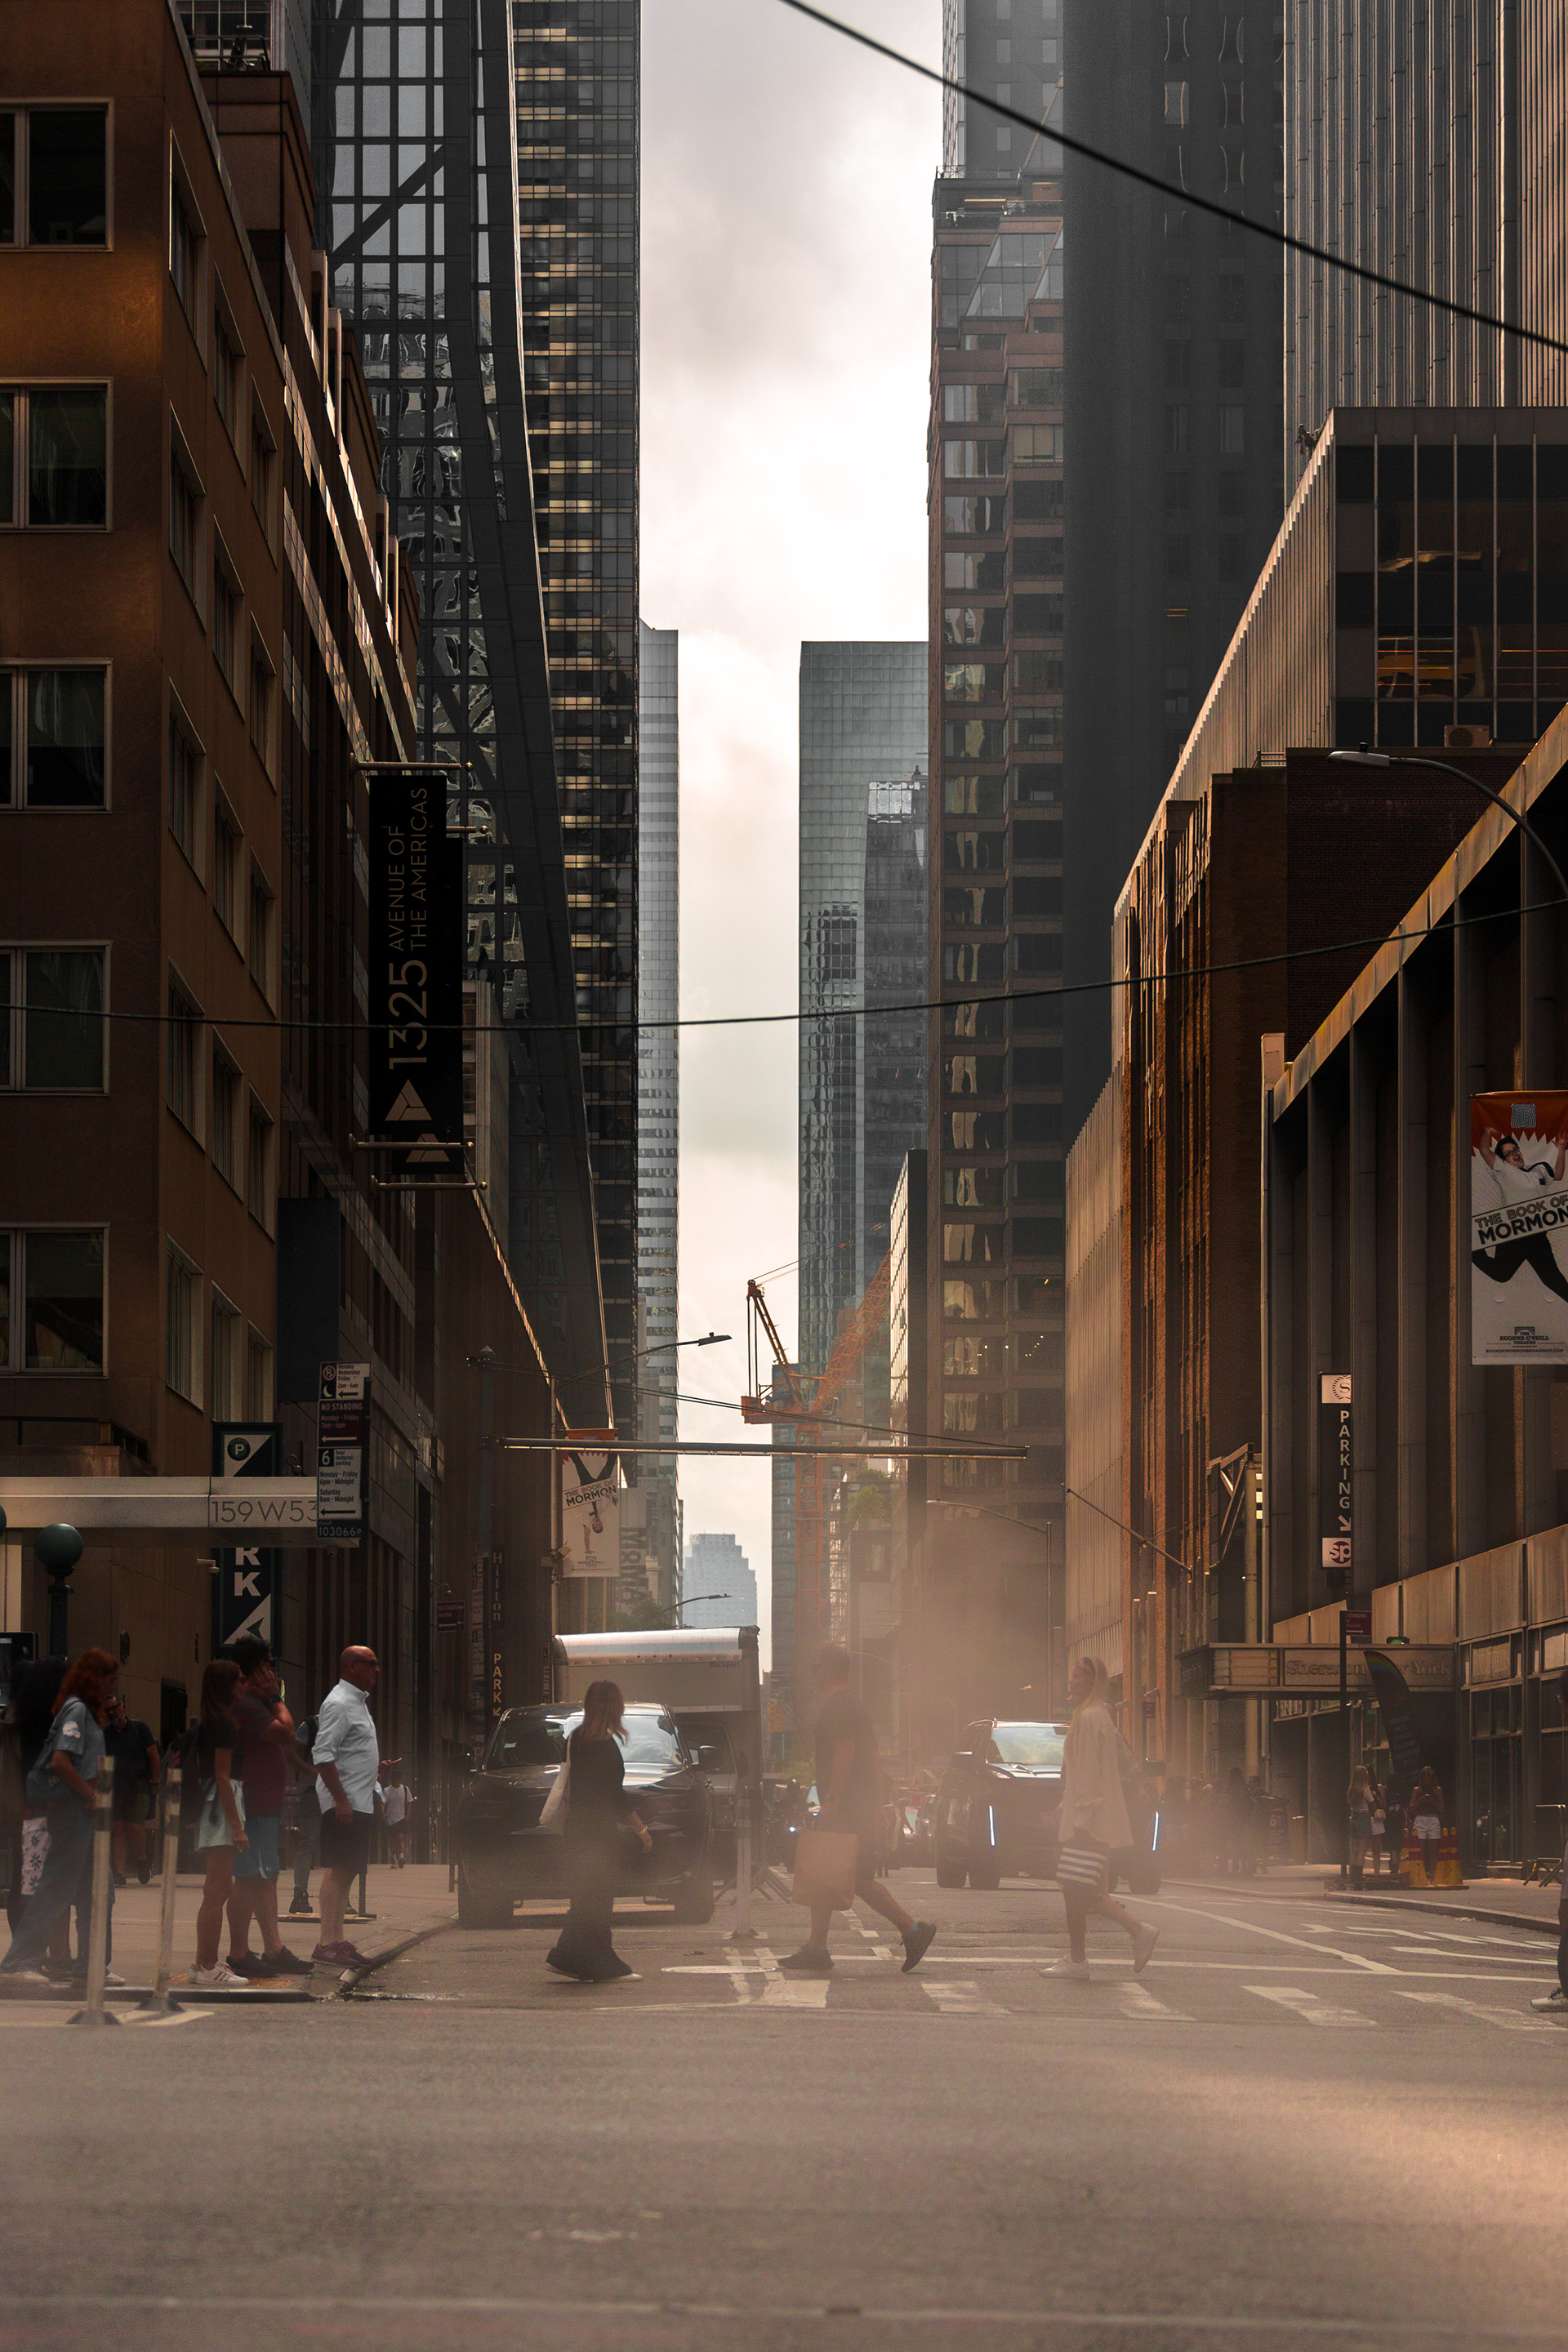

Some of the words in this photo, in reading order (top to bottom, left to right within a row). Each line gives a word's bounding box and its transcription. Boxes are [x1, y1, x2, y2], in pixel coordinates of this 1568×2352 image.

[388, 826, 405, 855] OF
[410, 786, 428, 902] AMERICAS
[388, 863, 405, 952] AVENUE
[410, 909, 428, 952] THE
[388, 959, 428, 1071] 1325
[1474, 1211, 1503, 1230] THE
[1507, 1198, 1548, 1222] BOOK
[1550, 1193, 1568, 1209] OF
[1477, 1206, 1568, 1245] MORMON
[321, 1403, 331, 1411] NO
[332, 1402, 363, 1411] STANDING
[234, 1444, 245, 1455] P
[321, 1449, 331, 1466] 6
[1339, 1410, 1351, 1509] PARKING
[565, 1488, 580, 1498] THE
[581, 1482, 604, 1494] BOOK
[604, 1478, 615, 1487] OF
[566, 1485, 617, 1507] MORMON
[492, 1552, 502, 1621] Hilton
[493, 1653, 503, 1704] PARK
[710, 1660, 741, 1669] Rockport
[1285, 1659, 1366, 1676] Sheraon
[1410, 1659, 1452, 1676] York
